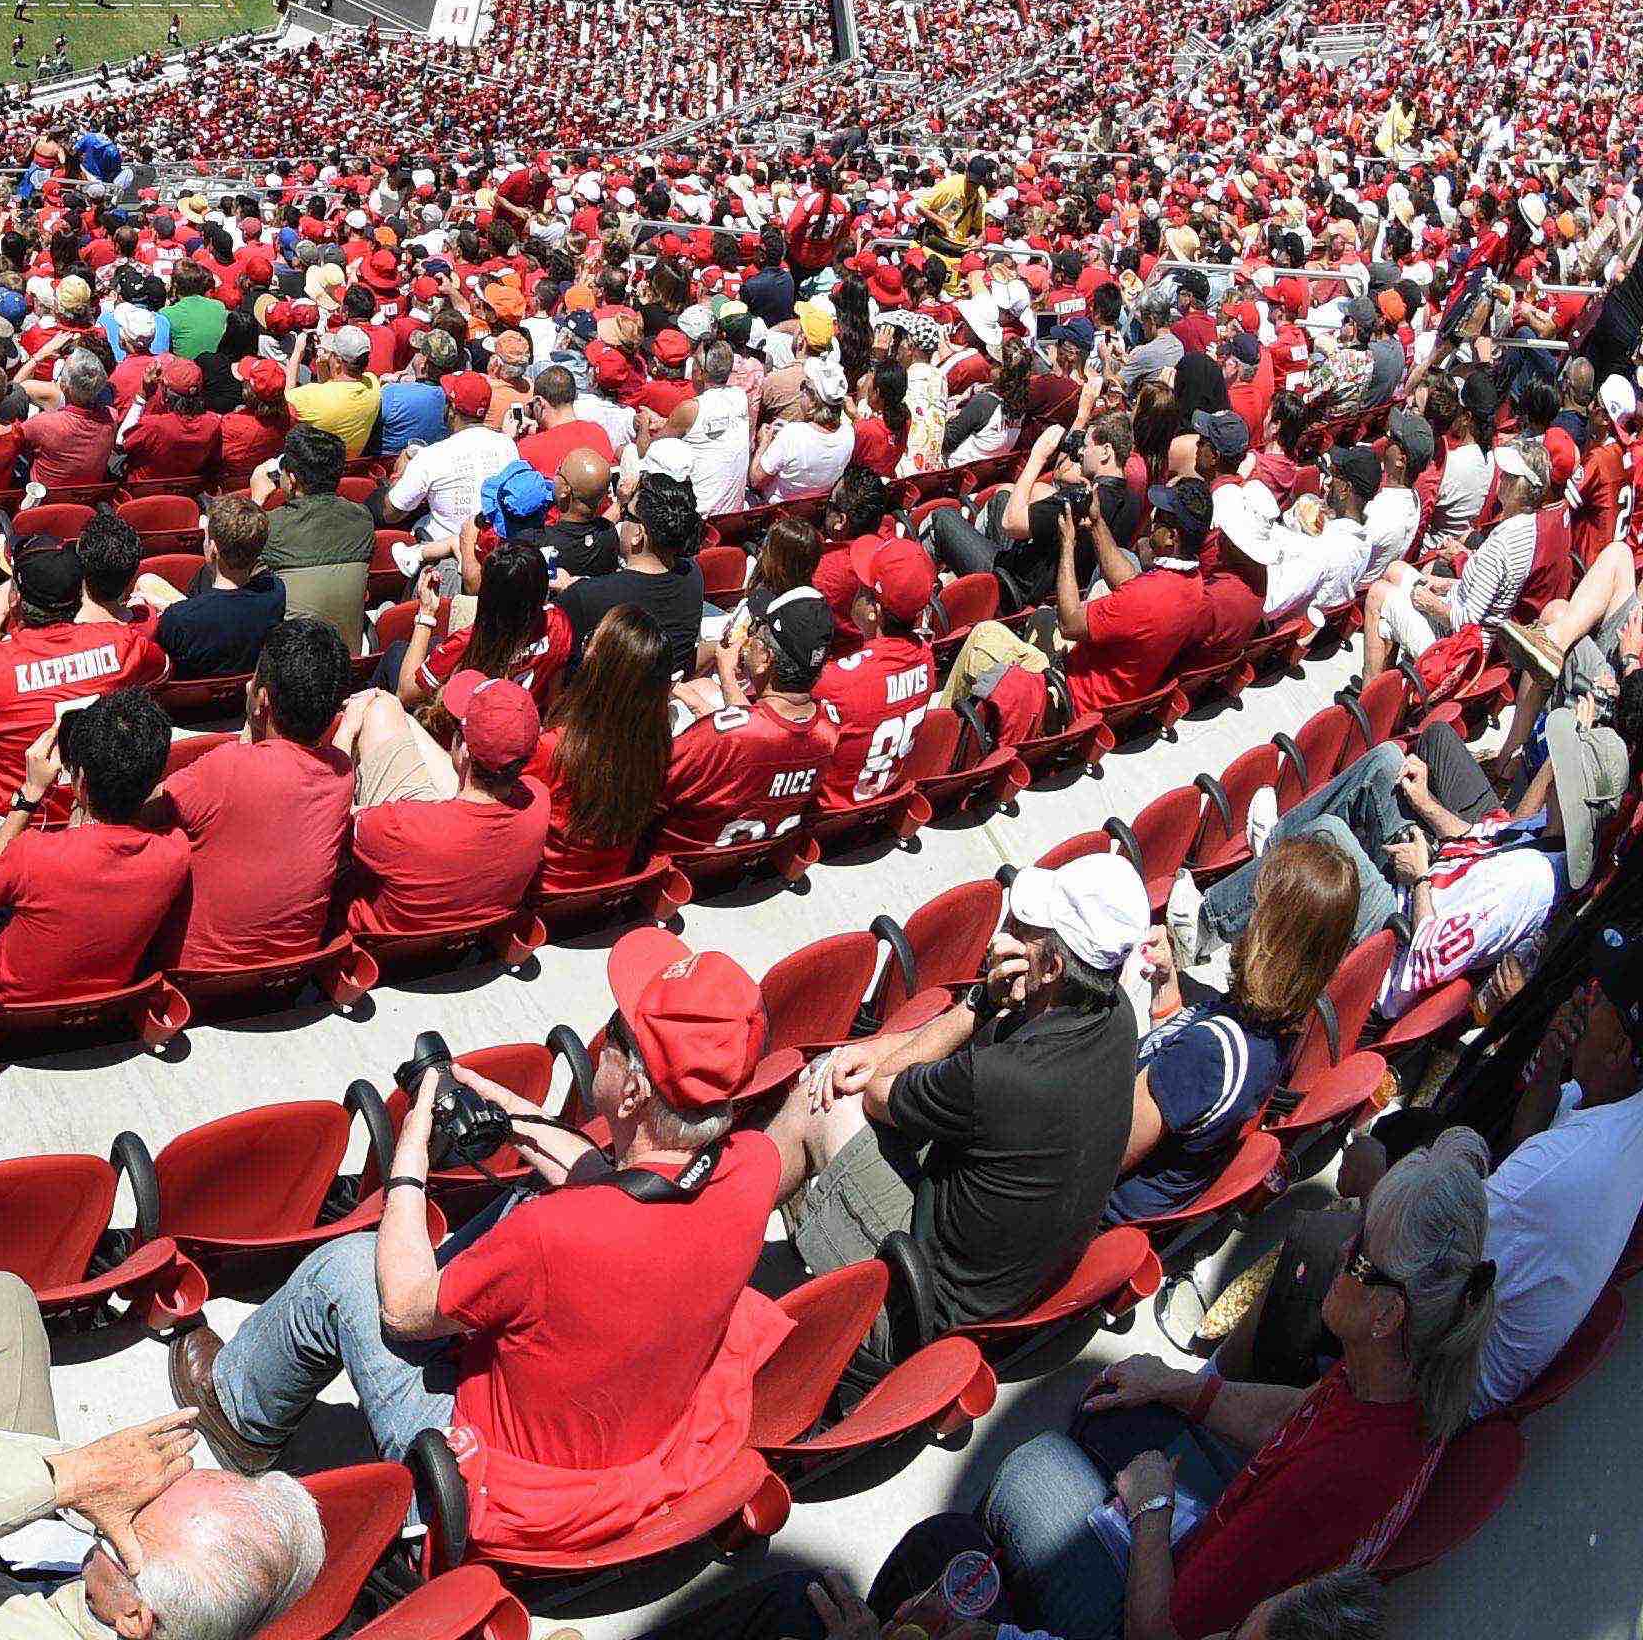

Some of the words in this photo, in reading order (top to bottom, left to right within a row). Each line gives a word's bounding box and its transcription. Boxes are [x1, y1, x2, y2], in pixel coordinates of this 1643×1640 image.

[14, 644, 120, 694] KAEPERNICK
[886, 663, 929, 704] DAVIS
[768, 768, 816, 798] RICE
